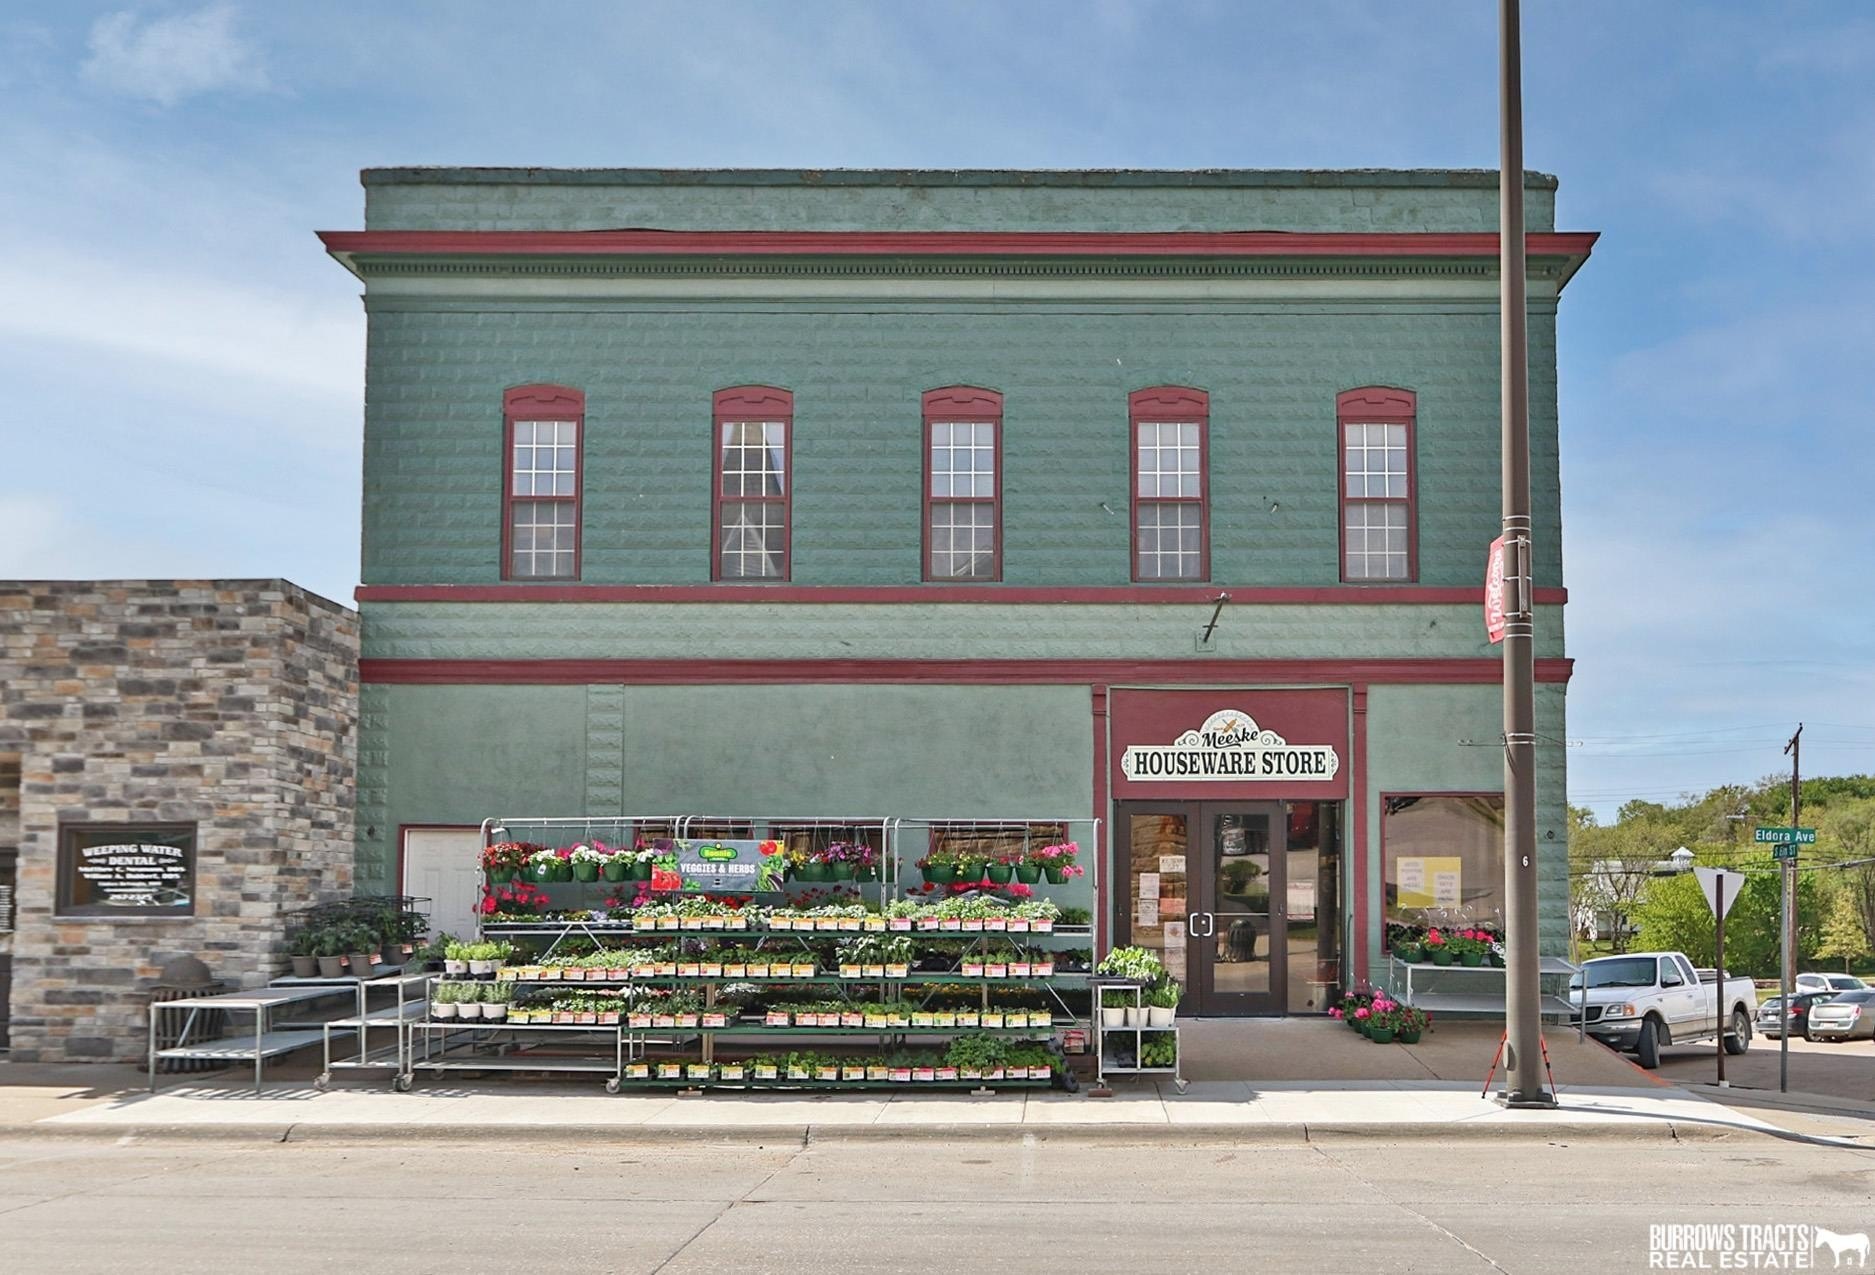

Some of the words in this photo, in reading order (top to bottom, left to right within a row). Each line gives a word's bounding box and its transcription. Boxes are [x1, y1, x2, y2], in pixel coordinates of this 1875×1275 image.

[1202, 728, 1258, 749] Meeske
[1134, 752, 1256, 775] HOUSEWARE
[1262, 751, 1326, 775] STORE
[1755, 830, 1790, 841] Eldora
[1795, 831, 1815, 842] Ave
[82, 844, 138, 857] WEEPING
[140, 844, 183, 858] WATER
[108, 857, 157, 865] DENTAL
[1522, 855, 1529, 867] 6
[680, 863, 717, 874] VEGGIES
[718, 863, 726, 874] &
[728, 863, 756, 874] HERBS
